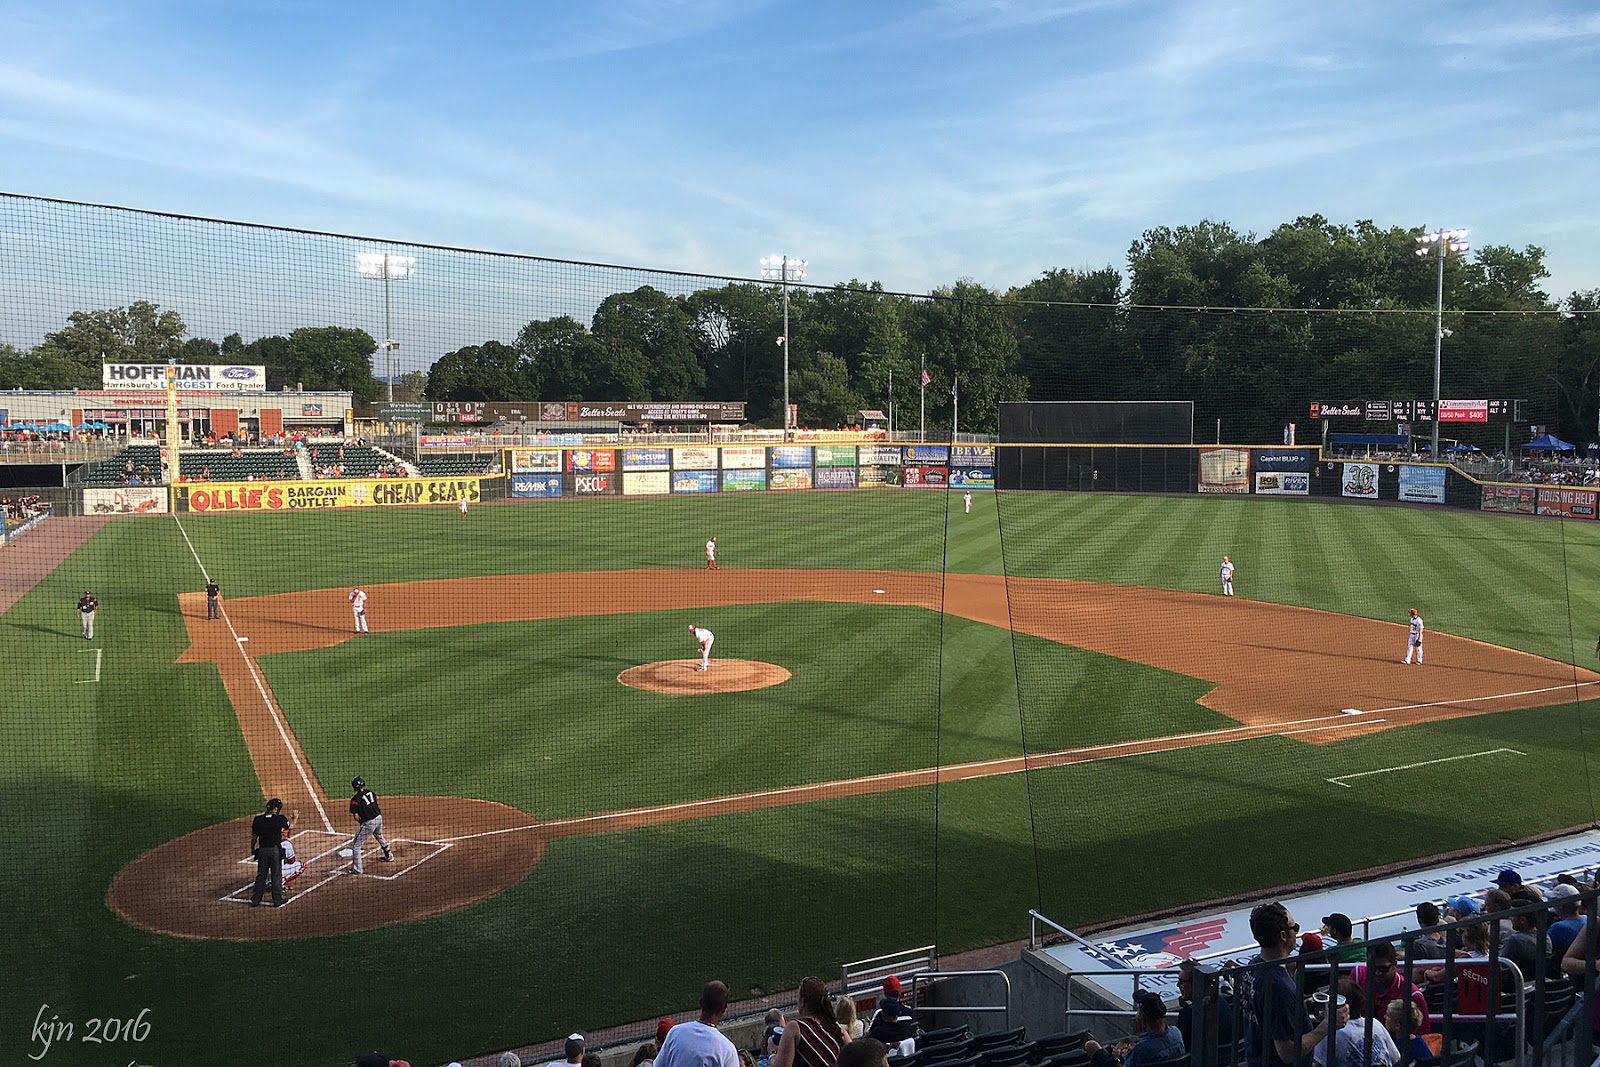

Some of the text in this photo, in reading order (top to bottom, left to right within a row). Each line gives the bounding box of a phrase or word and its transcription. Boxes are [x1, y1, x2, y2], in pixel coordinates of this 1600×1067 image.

[227, 368, 250, 379] Ford
[103, 381, 159, 390] Harrisburg's
[161, 381, 213, 389] LRGEST
[237, 382, 265, 390] Dealer
[436, 403, 444, 413] 0
[464, 403, 472, 413] 0
[579, 406, 626, 417] Better Seats
[1320, 404, 1342, 416] Better
[1341, 404, 1361, 416] Seats
[1260, 455, 1281, 463] Capital
[575, 476, 604, 492] PSECU
[1284, 476, 1307, 484] RIVER
[288, 486, 346, 498] BARGAIN
[373, 481, 479, 504] CHEAP SEATS
[514, 481, 547, 492] RE/MAX
[190, 486, 282, 511] OLLIE'S
[288, 497, 338, 508] OUTLET
[1574, 492, 1595, 505] HELP
[361, 791, 375, 806] 17
[1396, 842, 1598, 893] Online & Mobile Banking
[1462, 968, 1489, 985] SECTIO
